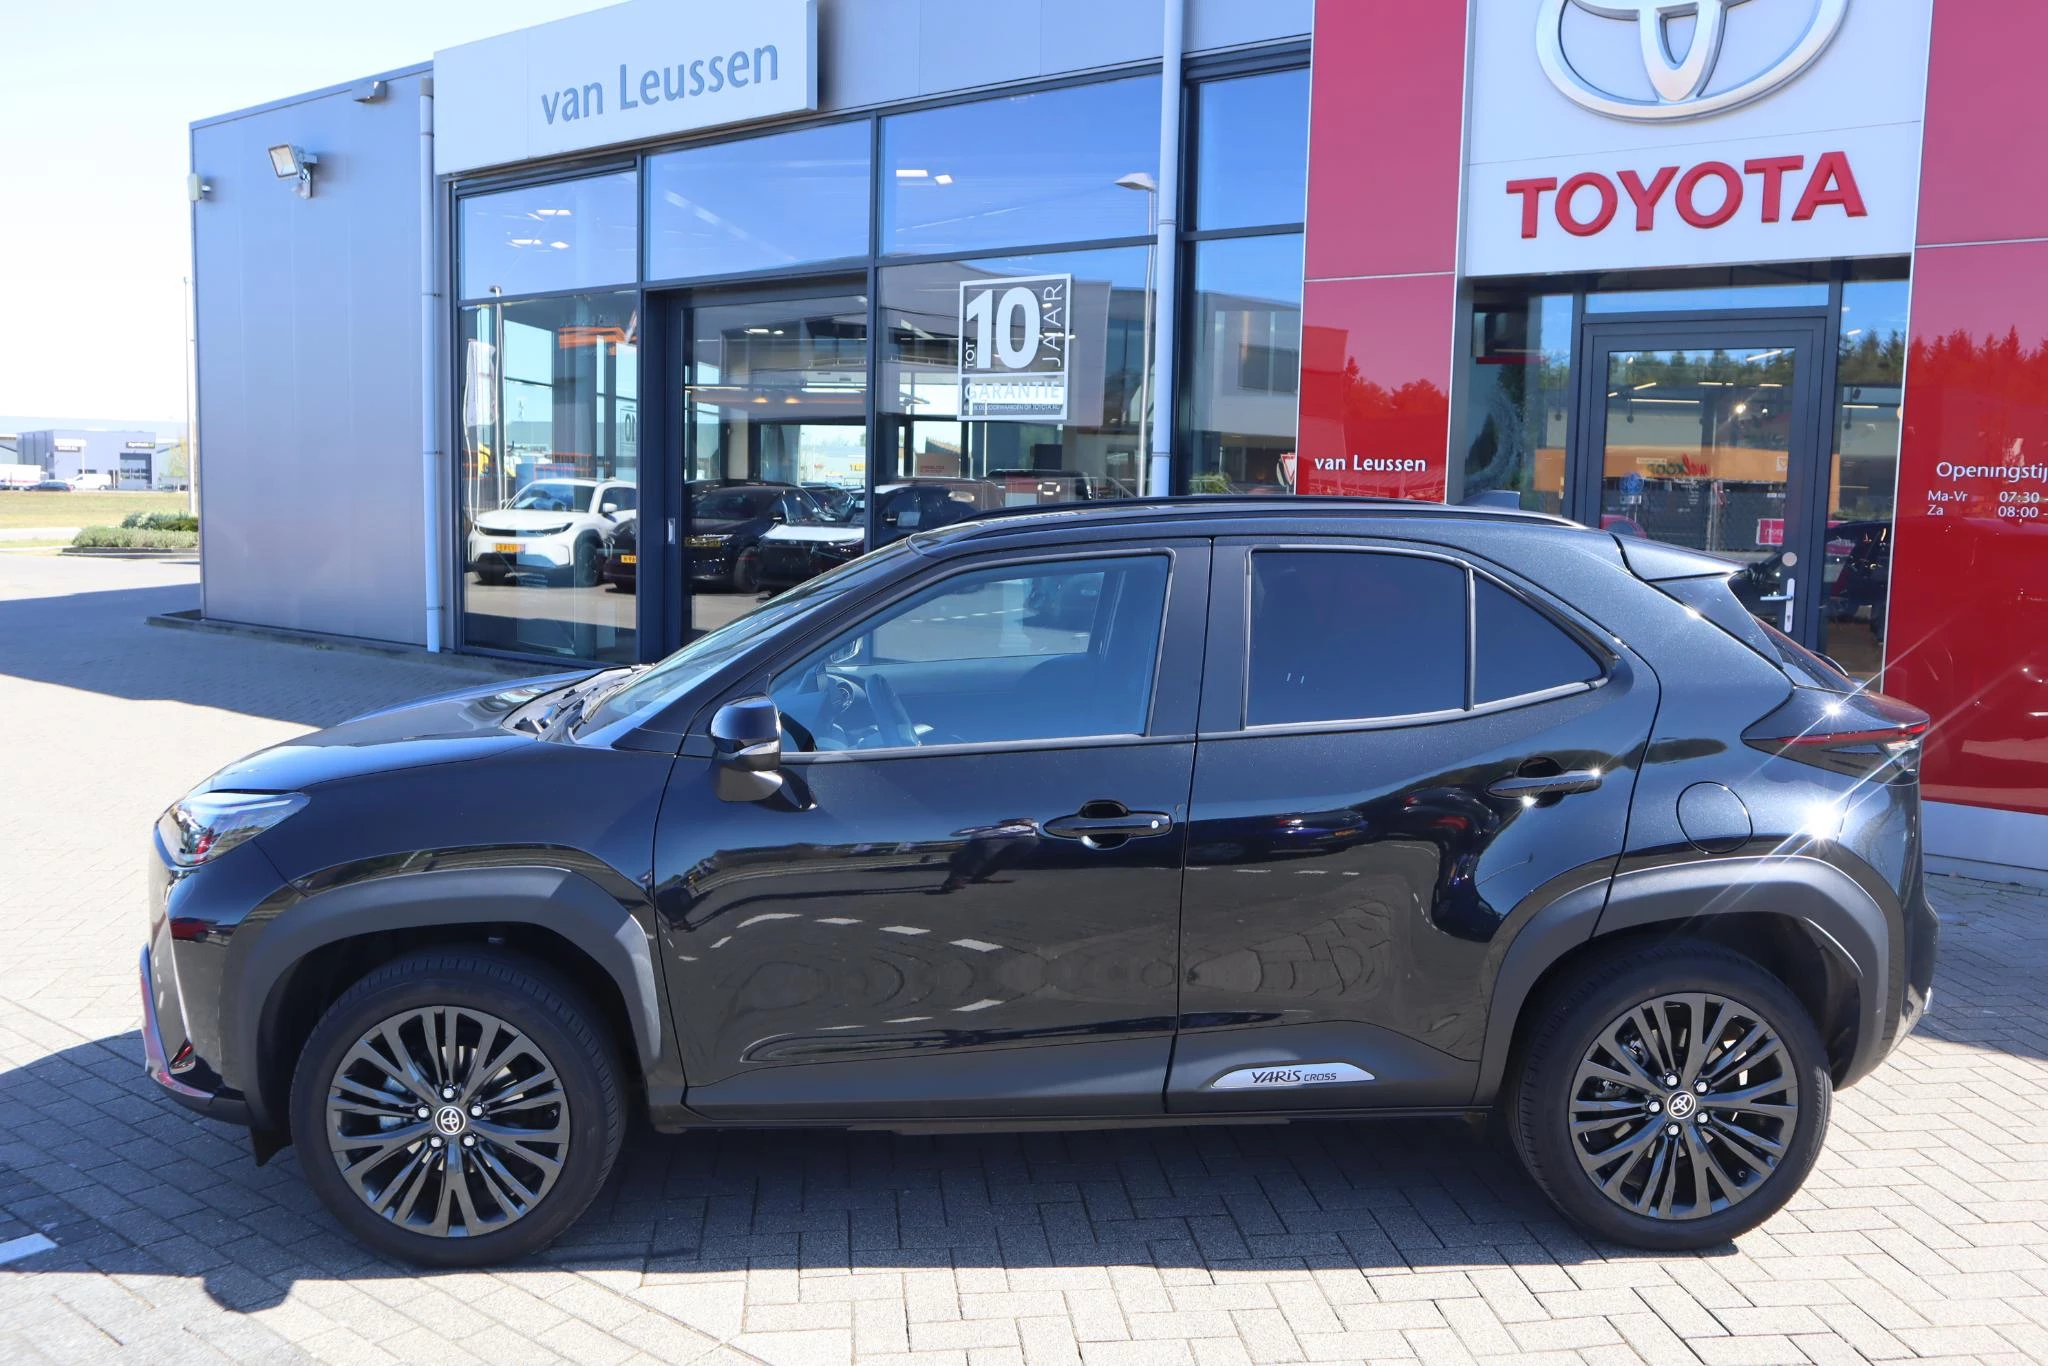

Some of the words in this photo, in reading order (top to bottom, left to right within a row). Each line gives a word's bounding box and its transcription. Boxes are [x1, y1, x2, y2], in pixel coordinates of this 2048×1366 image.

[541, 82, 604, 125] van
[620, 44, 778, 111] Leussen
[1505, 151, 1868, 239] TOYOTA
[966, 286, 1041, 369] 10
[1042, 284, 1062, 367] JAAR
[965, 341, 976, 369] TOT
[964, 381, 1061, 400] GARANTIE
[1314, 457, 1346, 471] van
[1353, 454, 1426, 472] Leussen
[1927, 490, 1968, 502] Ma-Vr
[1999, 491, 2040, 504] 07:30
[1927, 504, 1944, 516] Za
[1998, 505, 2039, 518] 08:00
[1303, 1072, 1337, 1082] CROSS
